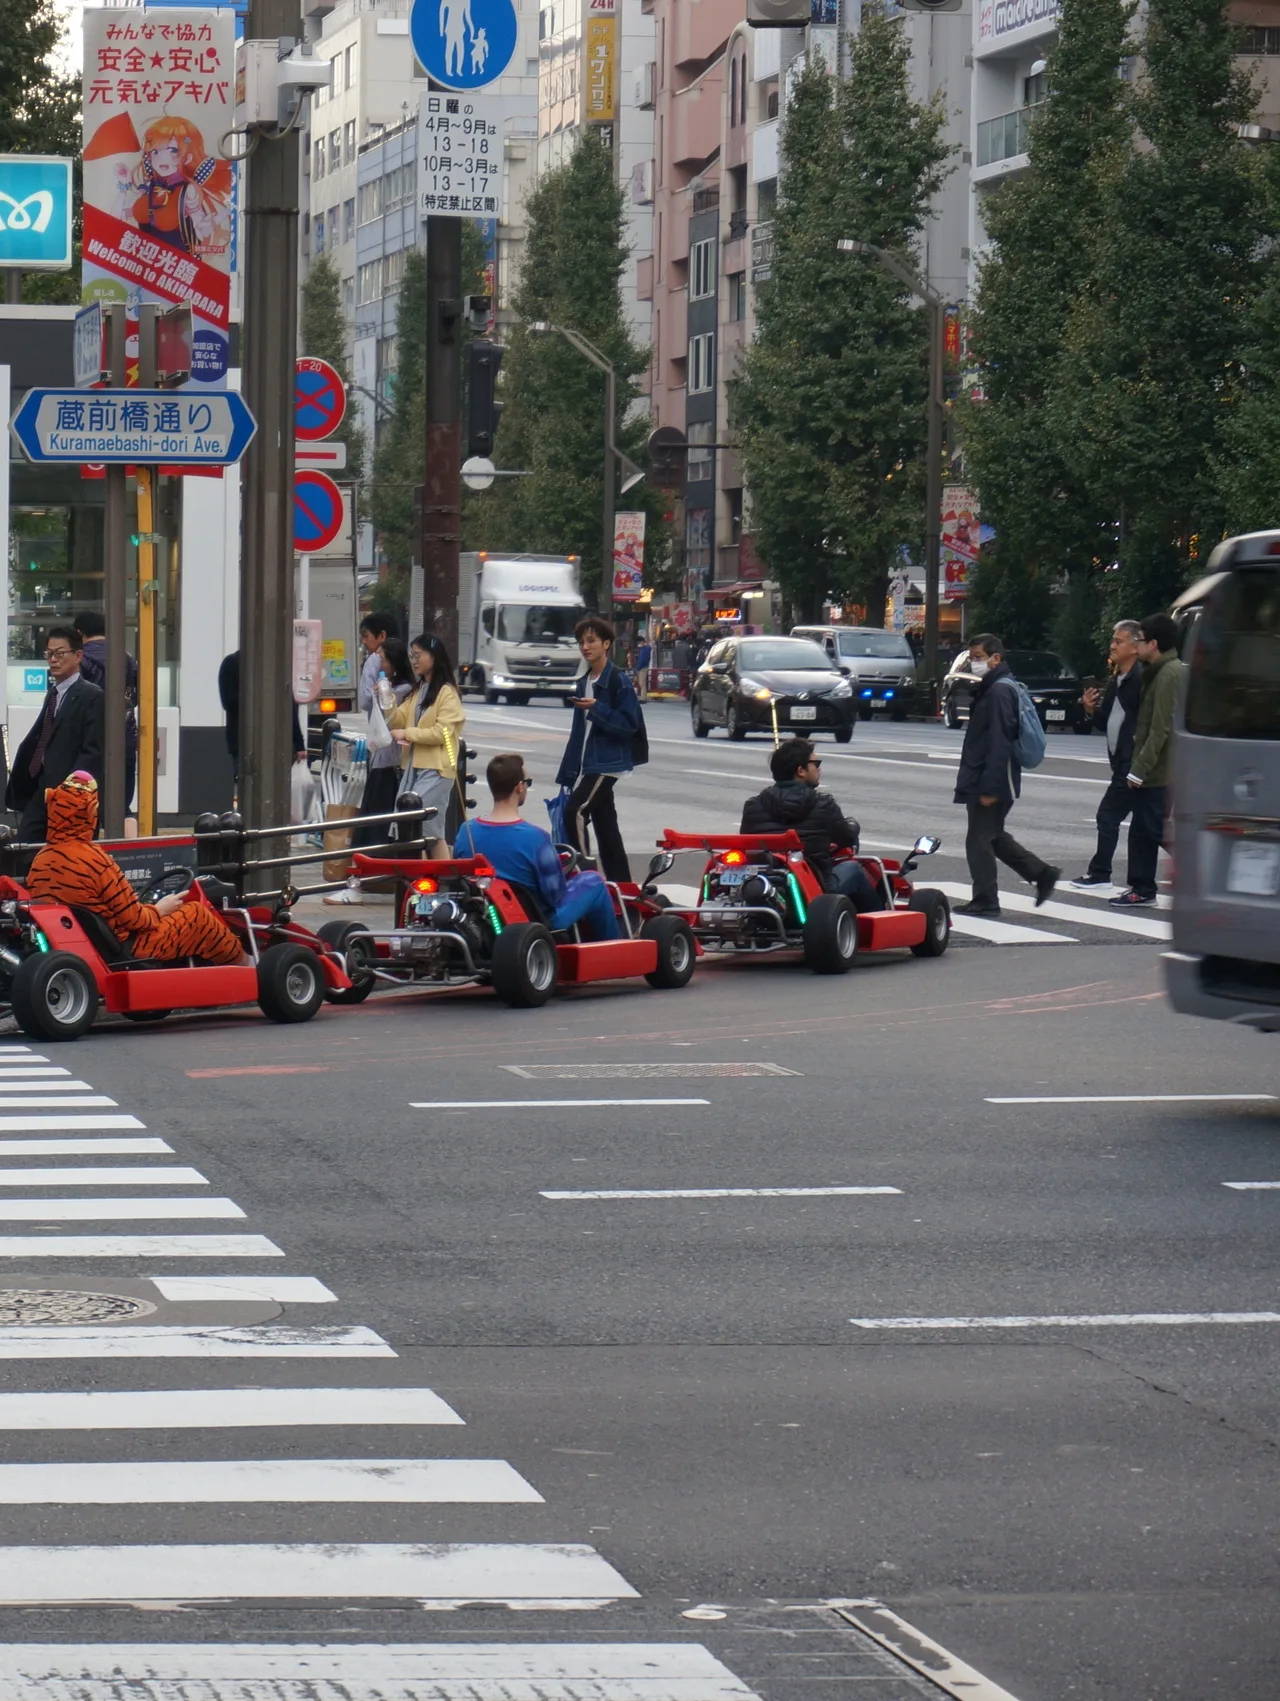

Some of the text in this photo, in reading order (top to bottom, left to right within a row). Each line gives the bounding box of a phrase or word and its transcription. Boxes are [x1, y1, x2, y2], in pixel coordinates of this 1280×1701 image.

[106, 23, 212, 41] みんなで協力
[88, 79, 229, 104] 元気なアキバ
[87, 239, 225, 318] Welcome to AKIHABARA
[55, 400, 213, 434] 蔵前橋通り
[50, 433, 224, 454] Kuramaebashi-dori Ave.
